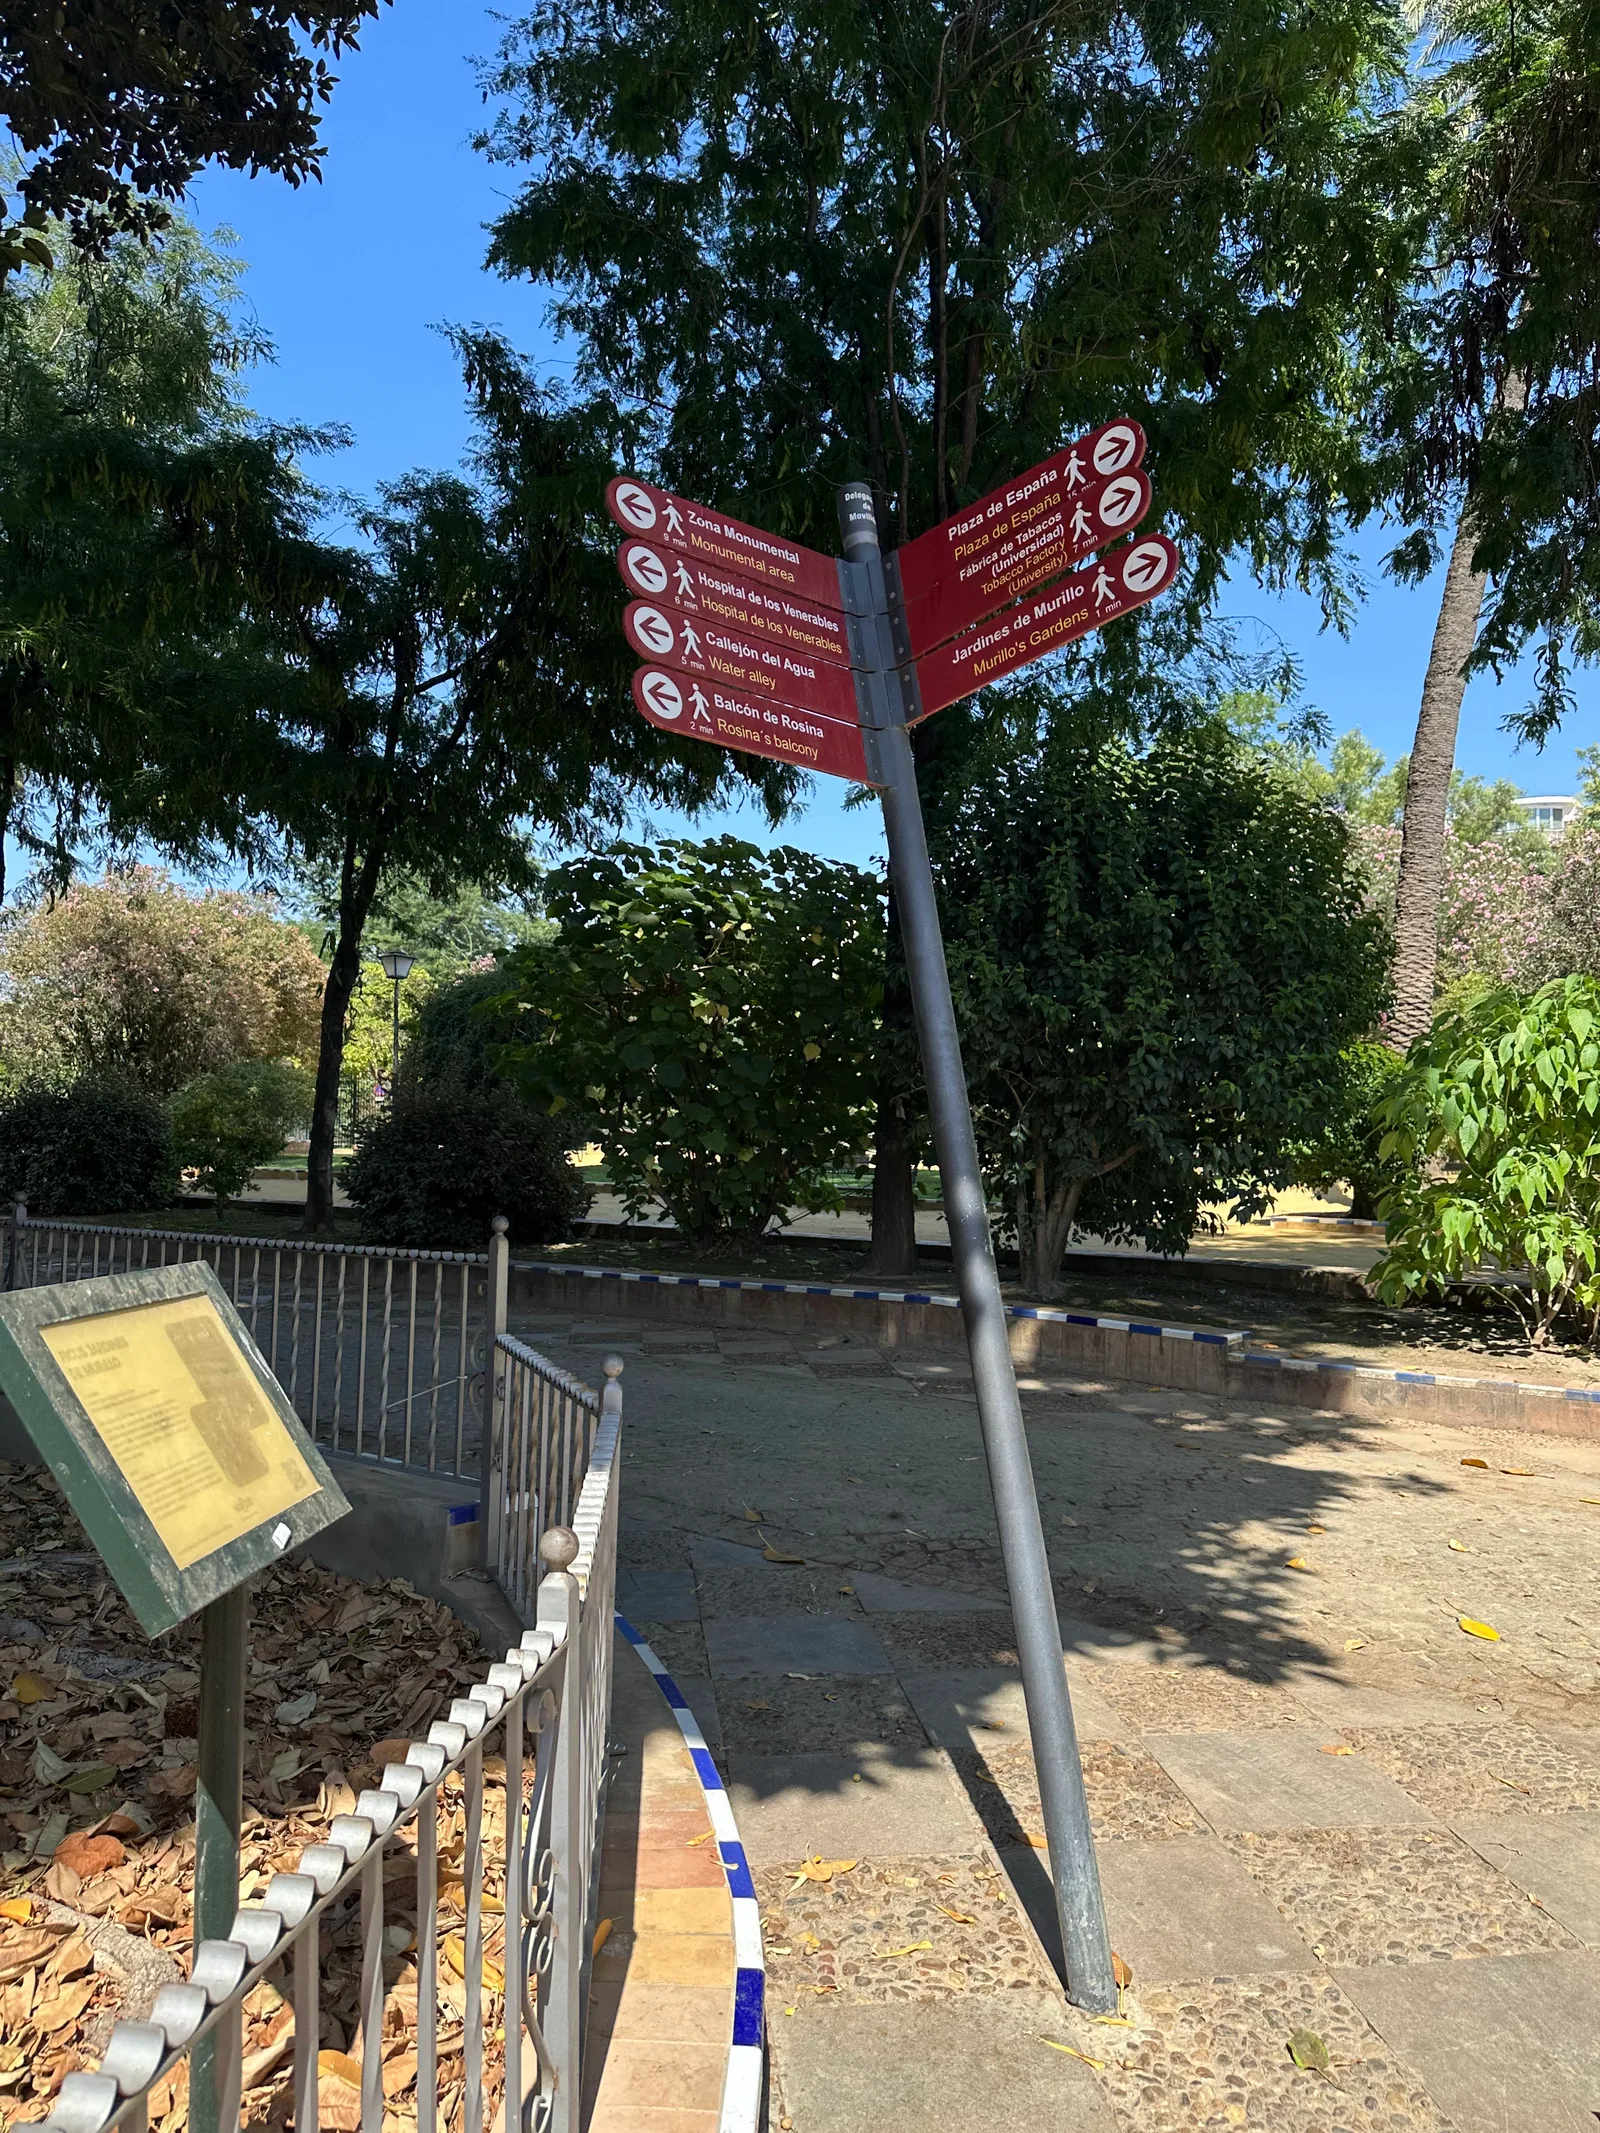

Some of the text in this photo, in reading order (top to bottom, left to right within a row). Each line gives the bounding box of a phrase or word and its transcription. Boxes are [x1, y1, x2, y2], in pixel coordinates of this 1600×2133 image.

[948, 469, 1058, 541] Plaza de España
[954, 492, 1061, 561] Plaza de España
[663, 533, 687, 548] 9 min
[687, 510, 799, 564] Zona Monumental
[691, 533, 794, 583] Monumental area
[959, 512, 1062, 581] Fábrica de Tabacos
[992, 524, 1064, 577] (Universidad)
[1073, 534, 1098, 554] 7 min
[981, 538, 1065, 595] Tobacco Factory
[1008, 552, 1068, 596] (University)
[675, 596, 698, 610] 6 min
[698, 571, 838, 633] Hospital de los Venerables
[701, 595, 842, 654] Hospital de los Venerables
[952, 585, 1084, 664] Jardines de Murillo
[1096, 599, 1122, 618] 1 min
[682, 656, 705, 670] 5 min
[706, 632, 815, 679] Callejón del Agua
[973, 608, 1089, 676] Murillo's Gardens
[708, 655, 776, 690] Water alley
[690, 722, 714, 735] 2 min
[714, 693, 824, 738] Balcón de Rosina
[774, 734, 818, 761] balcony
